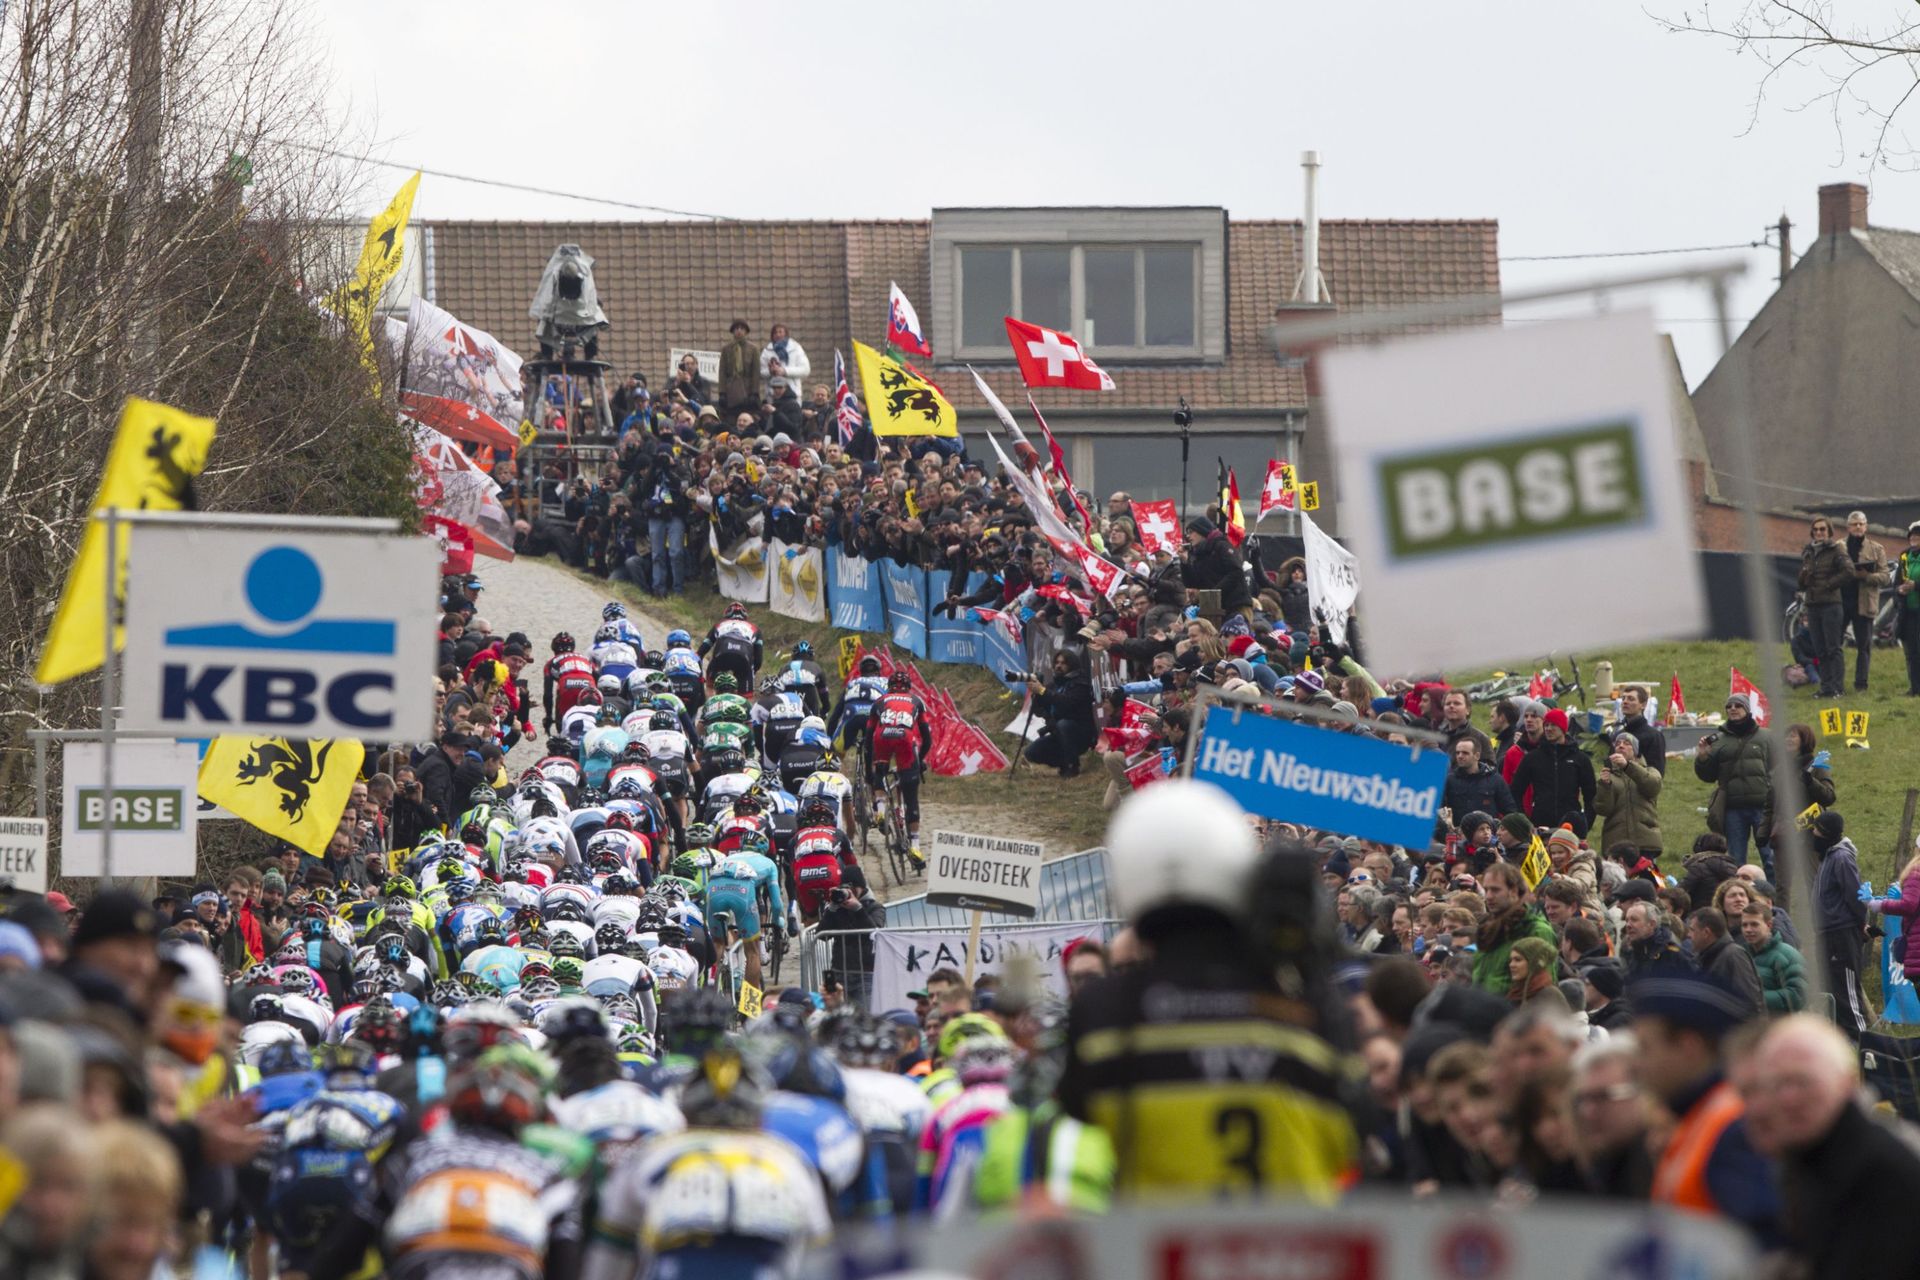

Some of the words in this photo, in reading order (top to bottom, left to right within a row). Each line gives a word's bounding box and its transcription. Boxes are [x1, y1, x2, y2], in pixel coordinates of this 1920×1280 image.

[1395, 439, 1629, 542] BASE
[161, 663, 395, 730] KBC
[1201, 735, 1255, 780] Het
[1258, 748, 1437, 820] Nieuwsblad
[85, 796, 174, 823] BASE
[937, 831, 963, 848] RONDE
[967, 836, 985, 850] VAN
[986, 839, 1041, 857] VLAANDEREN
[800, 866, 828, 877] BMC
[938, 854, 1033, 889] OVERSTEEK
[1214, 1104, 1262, 1203] 3
